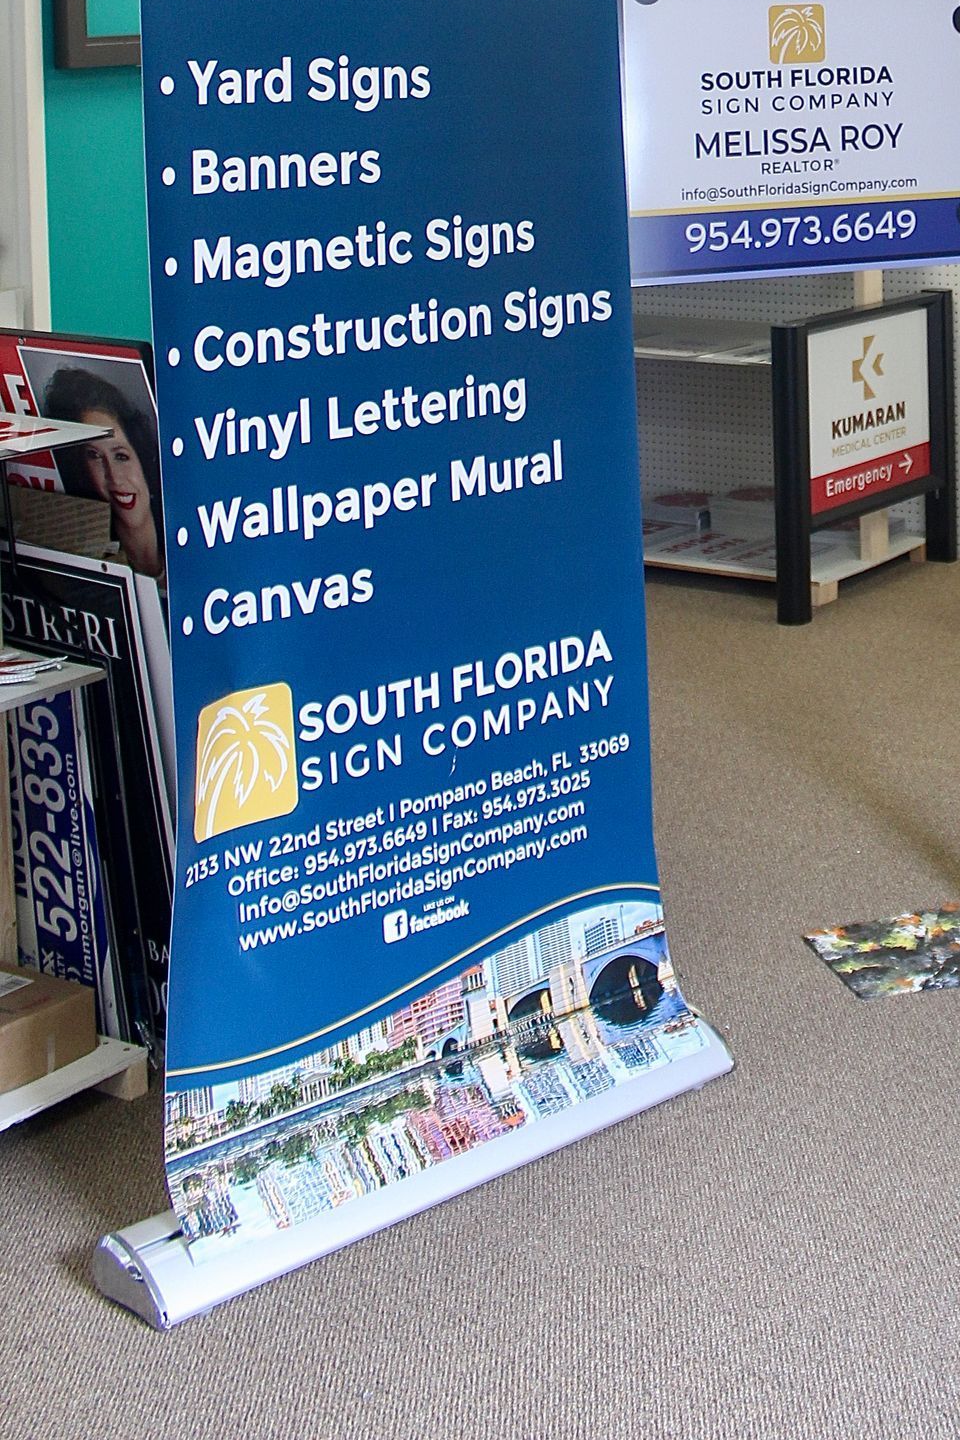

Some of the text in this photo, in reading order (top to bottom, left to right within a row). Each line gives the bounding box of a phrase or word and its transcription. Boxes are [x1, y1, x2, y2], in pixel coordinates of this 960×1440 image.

[187, 55, 432, 112] Yard Signs
[700, 66, 893, 92] SOUTH FLORIDA
[701, 91, 893, 115] SIGN COMPANY
[192, 149, 381, 194] Banners
[695, 123, 903, 159] MELISSA ROY
[681, 176, 917, 202] info@SouthFloridaSignCompany.com
[193, 215, 535, 288] Magnetic Signs
[685, 209, 917, 253] 954.973.6649
[194, 286, 612, 372] Construction Signs
[195, 375, 526, 460] Vinyl Lettering
[832, 401, 906, 440] KUMARAN
[832, 426, 907, 458] MEDICAL CENTER
[198, 439, 562, 548] Wallpaper Mural
[826, 462, 893, 497] Emergency
[203, 567, 374, 636] Canvas
[298, 629, 613, 742] SOUTH FLORIDA
[301, 677, 615, 791] SIGN COMPANY
[18, 694, 78, 942] 522-835
[186, 855, 219, 888] 2133
[224, 841, 265, 872] NW
[269, 829, 321, 859] 22nd
[325, 808, 385, 846] Street
[402, 777, 487, 822] Pompano
[491, 762, 548, 792] Beach,
[552, 750, 572, 772] FL
[579, 734, 630, 764] 33069
[228, 864, 300, 896] Office:
[304, 822, 428, 876] 954.973.6649
[443, 806, 479, 832] Fax:
[482, 770, 591, 821] 954.973.3025
[239, 799, 585, 925] Info@SouthFloridaSignCompany.com
[239, 824, 588, 952] www.SouthFloridaSignCompany.com
[410, 899, 469, 934] facebook
